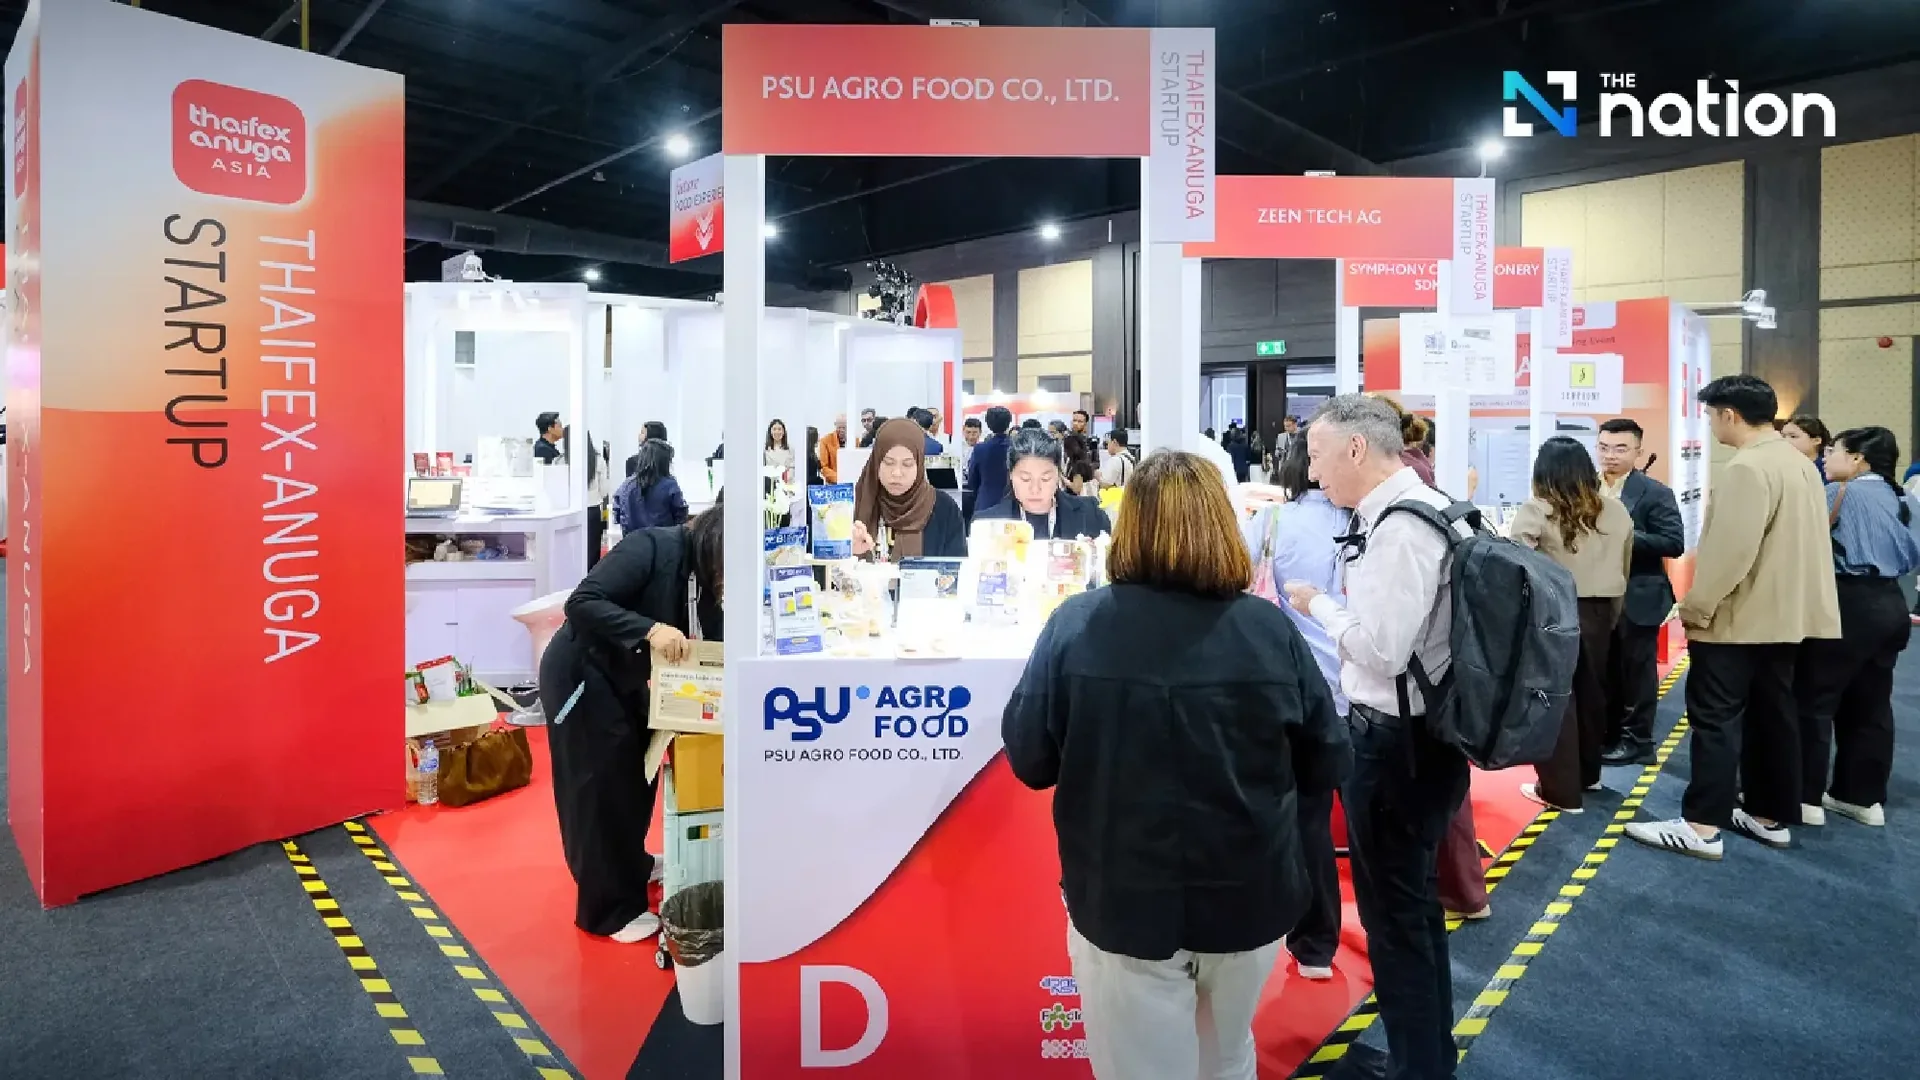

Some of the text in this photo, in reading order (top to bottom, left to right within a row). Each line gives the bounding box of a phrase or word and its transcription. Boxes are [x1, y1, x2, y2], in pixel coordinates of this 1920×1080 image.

[762, 75, 1119, 106] PSU AGRO FOOD CO., LTD.
[1160, 51, 1181, 147] STARTUP
[189, 103, 291, 143] thaifex
[1185, 50, 1206, 220] THAIFEX-ANUGA
[189, 130, 291, 163] anuga
[211, 157, 271, 179] ASIA
[1257, 208, 1382, 225] ZEEN TECH AG
[1460, 194, 1473, 255] STARTUP
[1474, 193, 1488, 300] THAIFEX-ANUGA
[1349, 263, 1426, 275] SYMPHONY
[163, 213, 229, 469] STARTUP
[260, 229, 320, 664] THAIFEX-ANUGA
[764, 686, 850, 742] PSU
[875, 685, 972, 710] AGRO
[875, 715, 969, 738] FOOD
[764, 748, 964, 762] PSU AGRO FOOD CO., LTD.
[800, 964, 889, 1067] D
